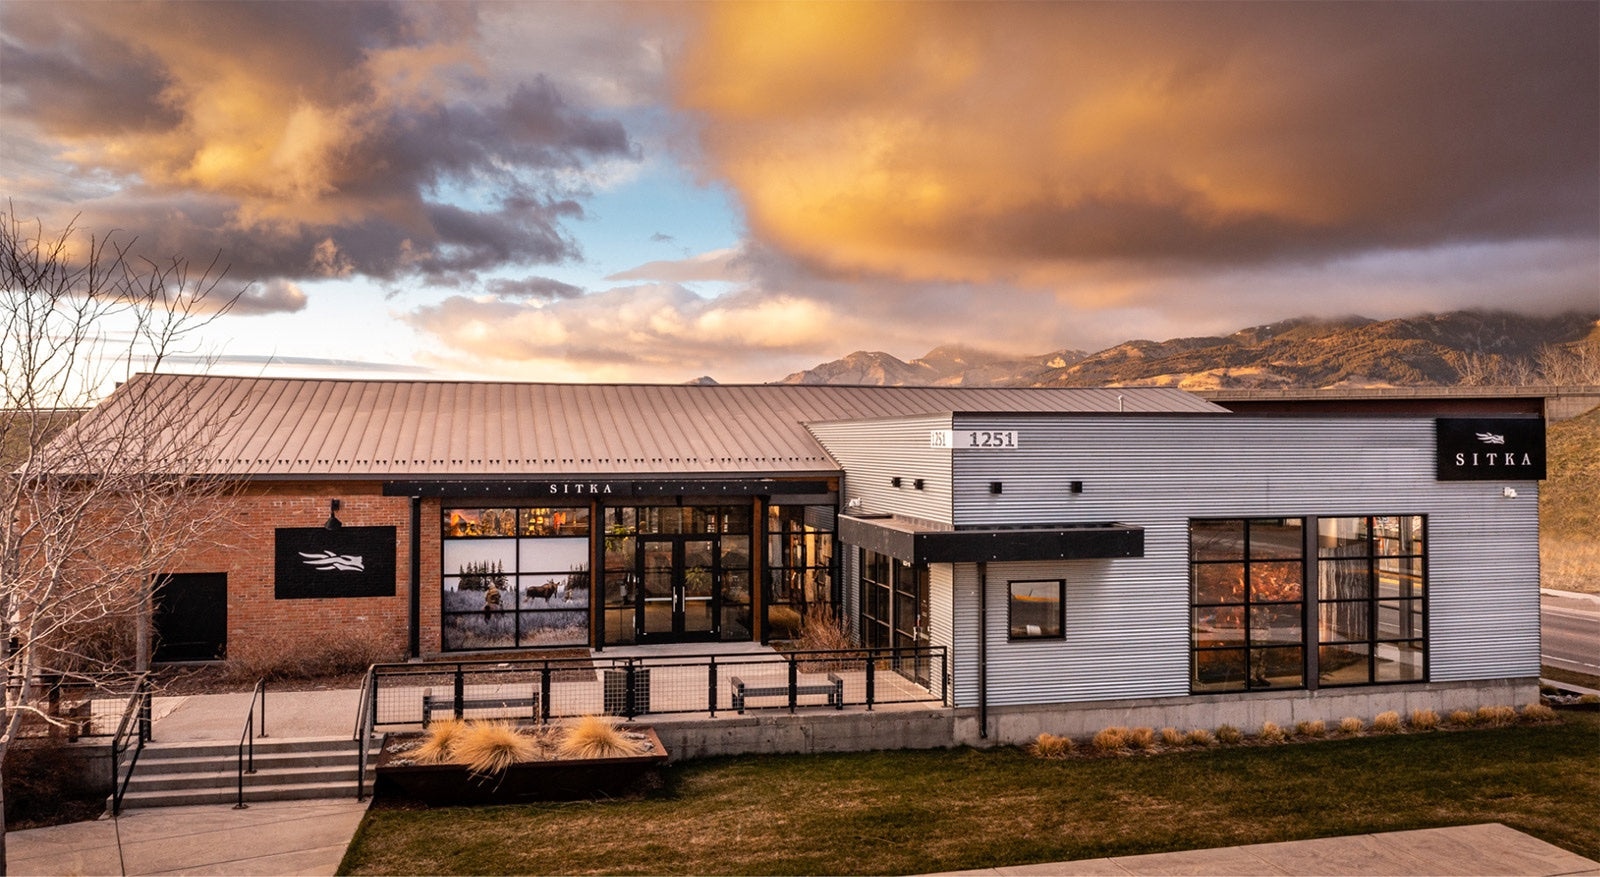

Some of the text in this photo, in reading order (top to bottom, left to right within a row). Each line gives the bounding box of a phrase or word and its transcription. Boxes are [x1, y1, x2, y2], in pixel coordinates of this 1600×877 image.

[932, 432, 946, 446] 1251
[969, 432, 1015, 447] 1251
[1456, 452, 1532, 466] SITKA
[549, 483, 612, 494] SITKA
